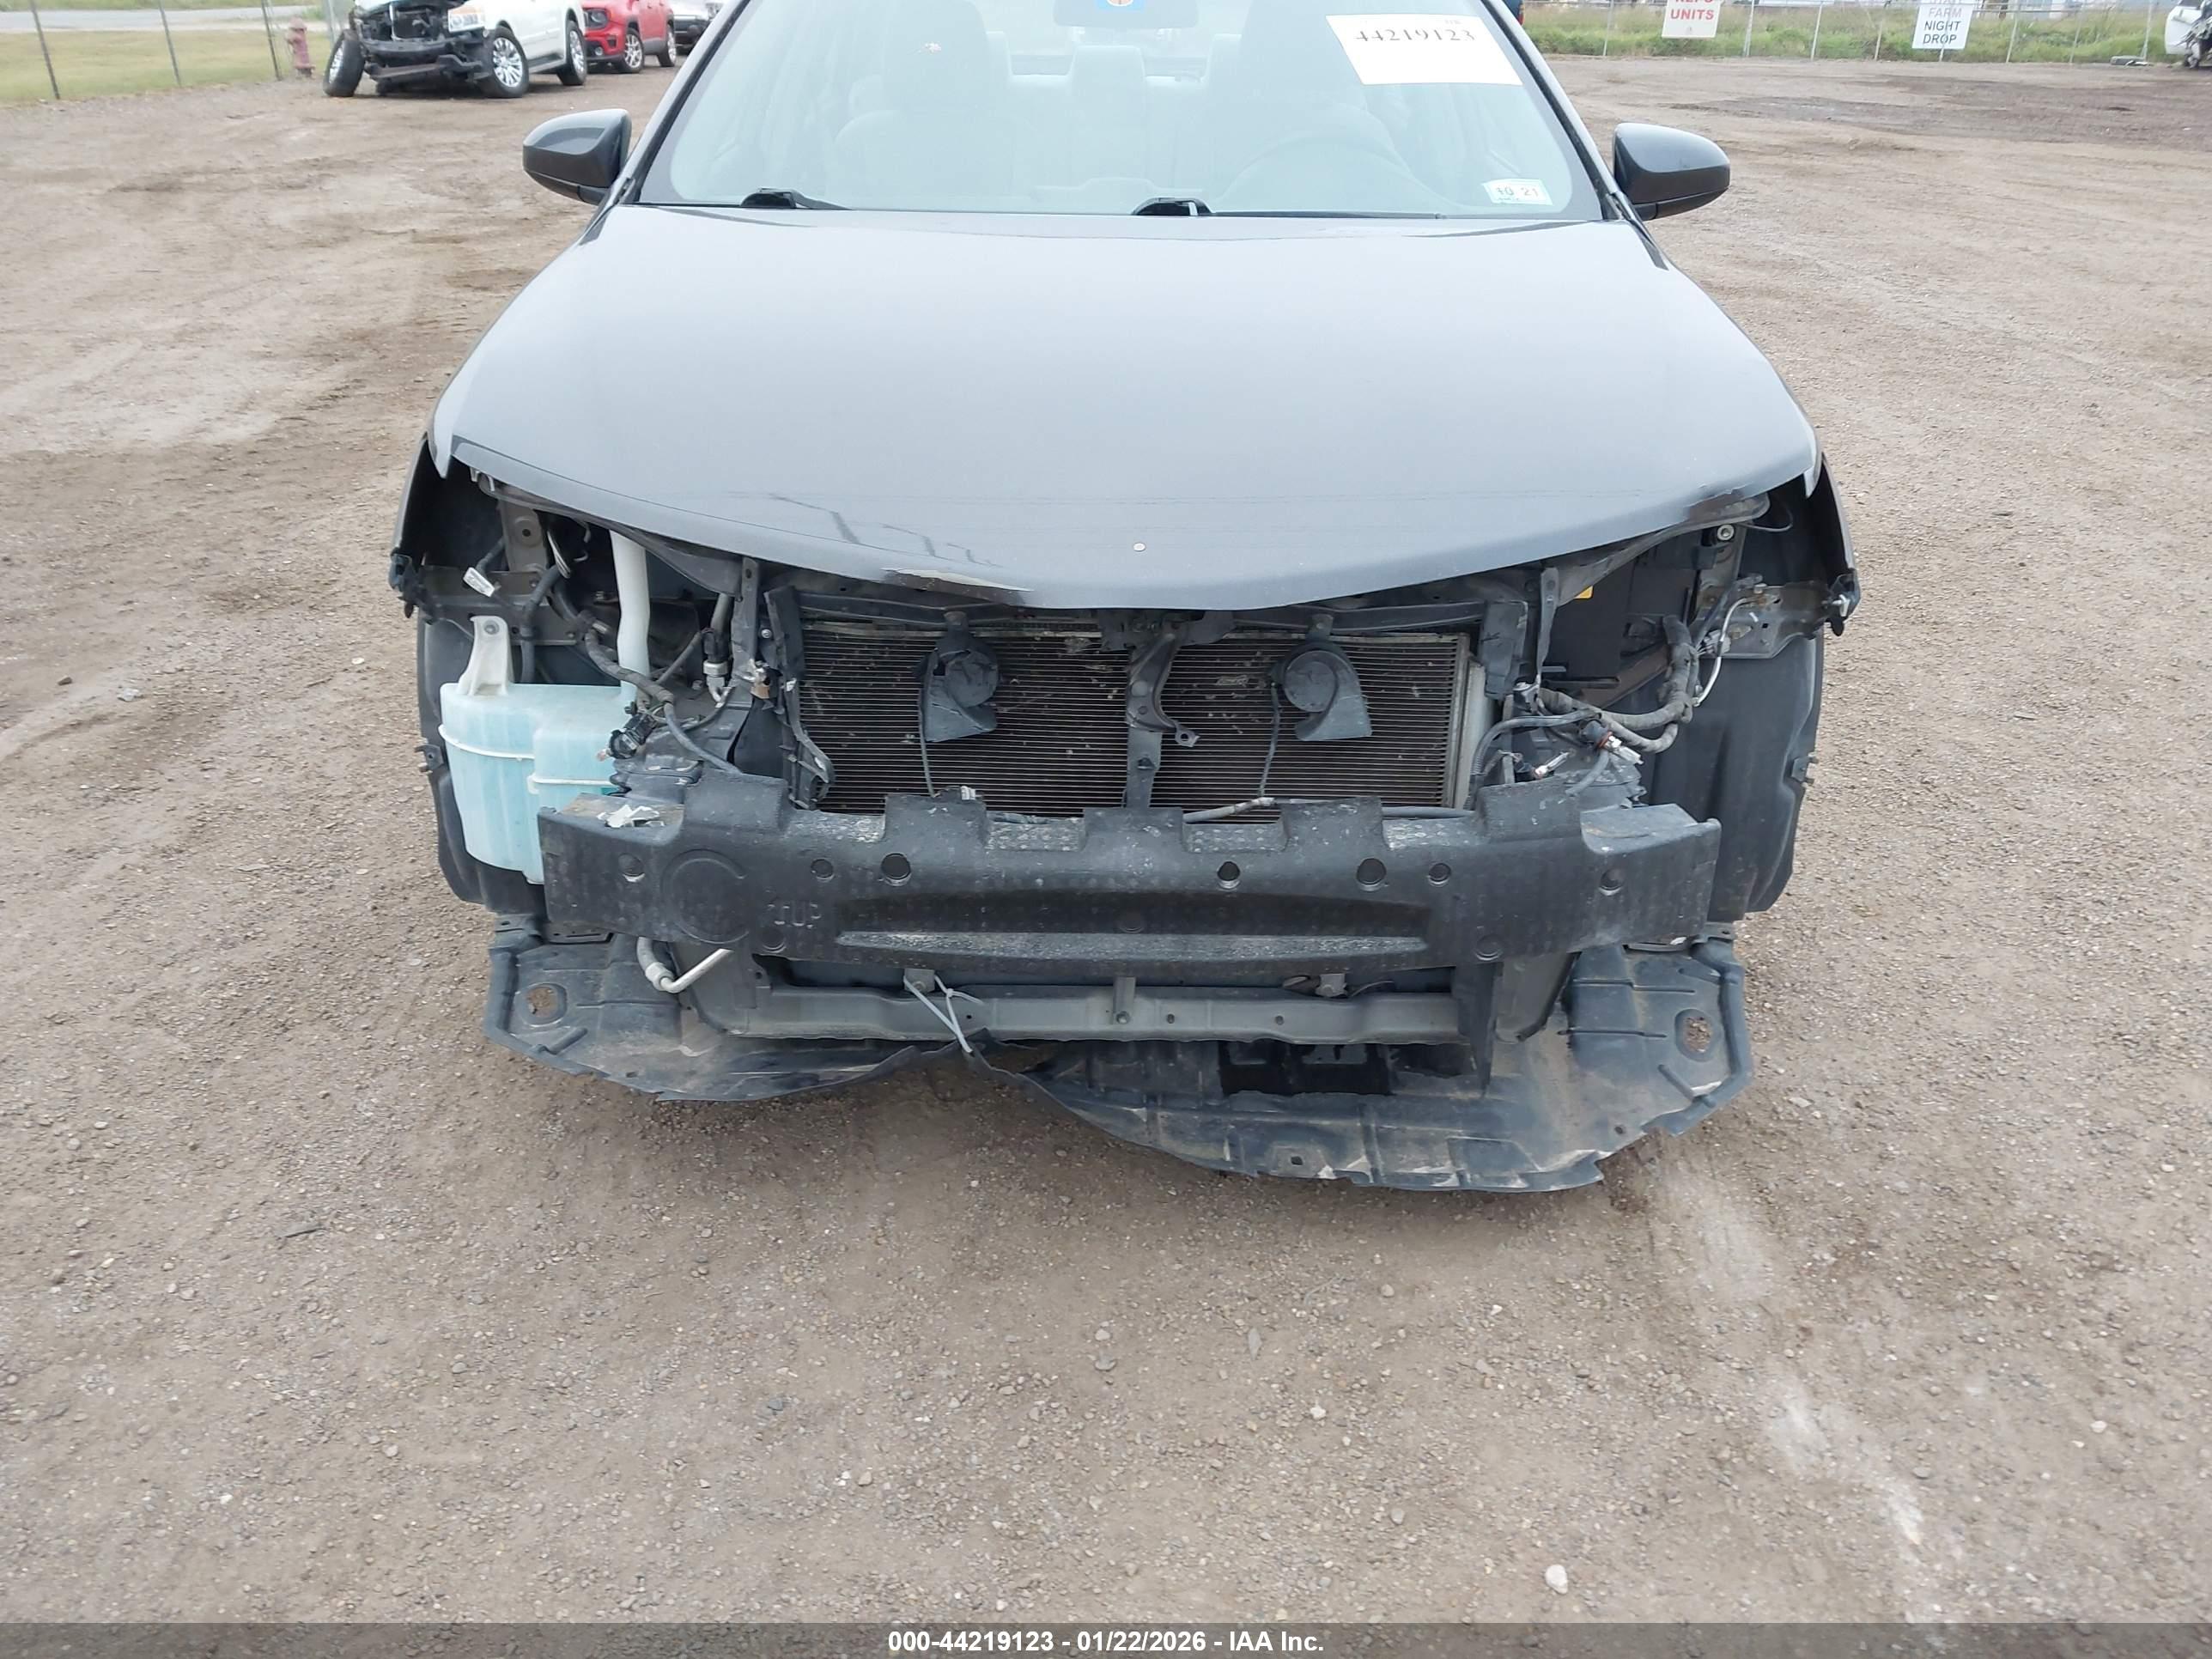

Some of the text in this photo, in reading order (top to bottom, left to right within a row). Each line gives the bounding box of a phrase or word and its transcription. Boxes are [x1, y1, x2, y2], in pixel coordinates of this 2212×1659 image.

[1670, 9, 1715, 21] UNITS
[1929, 8, 1962, 18] FARM
[1924, 21, 1961, 31] NIGHT
[1354, 28, 1475, 42] 44219123
[1923, 33, 1957, 45] DROP
